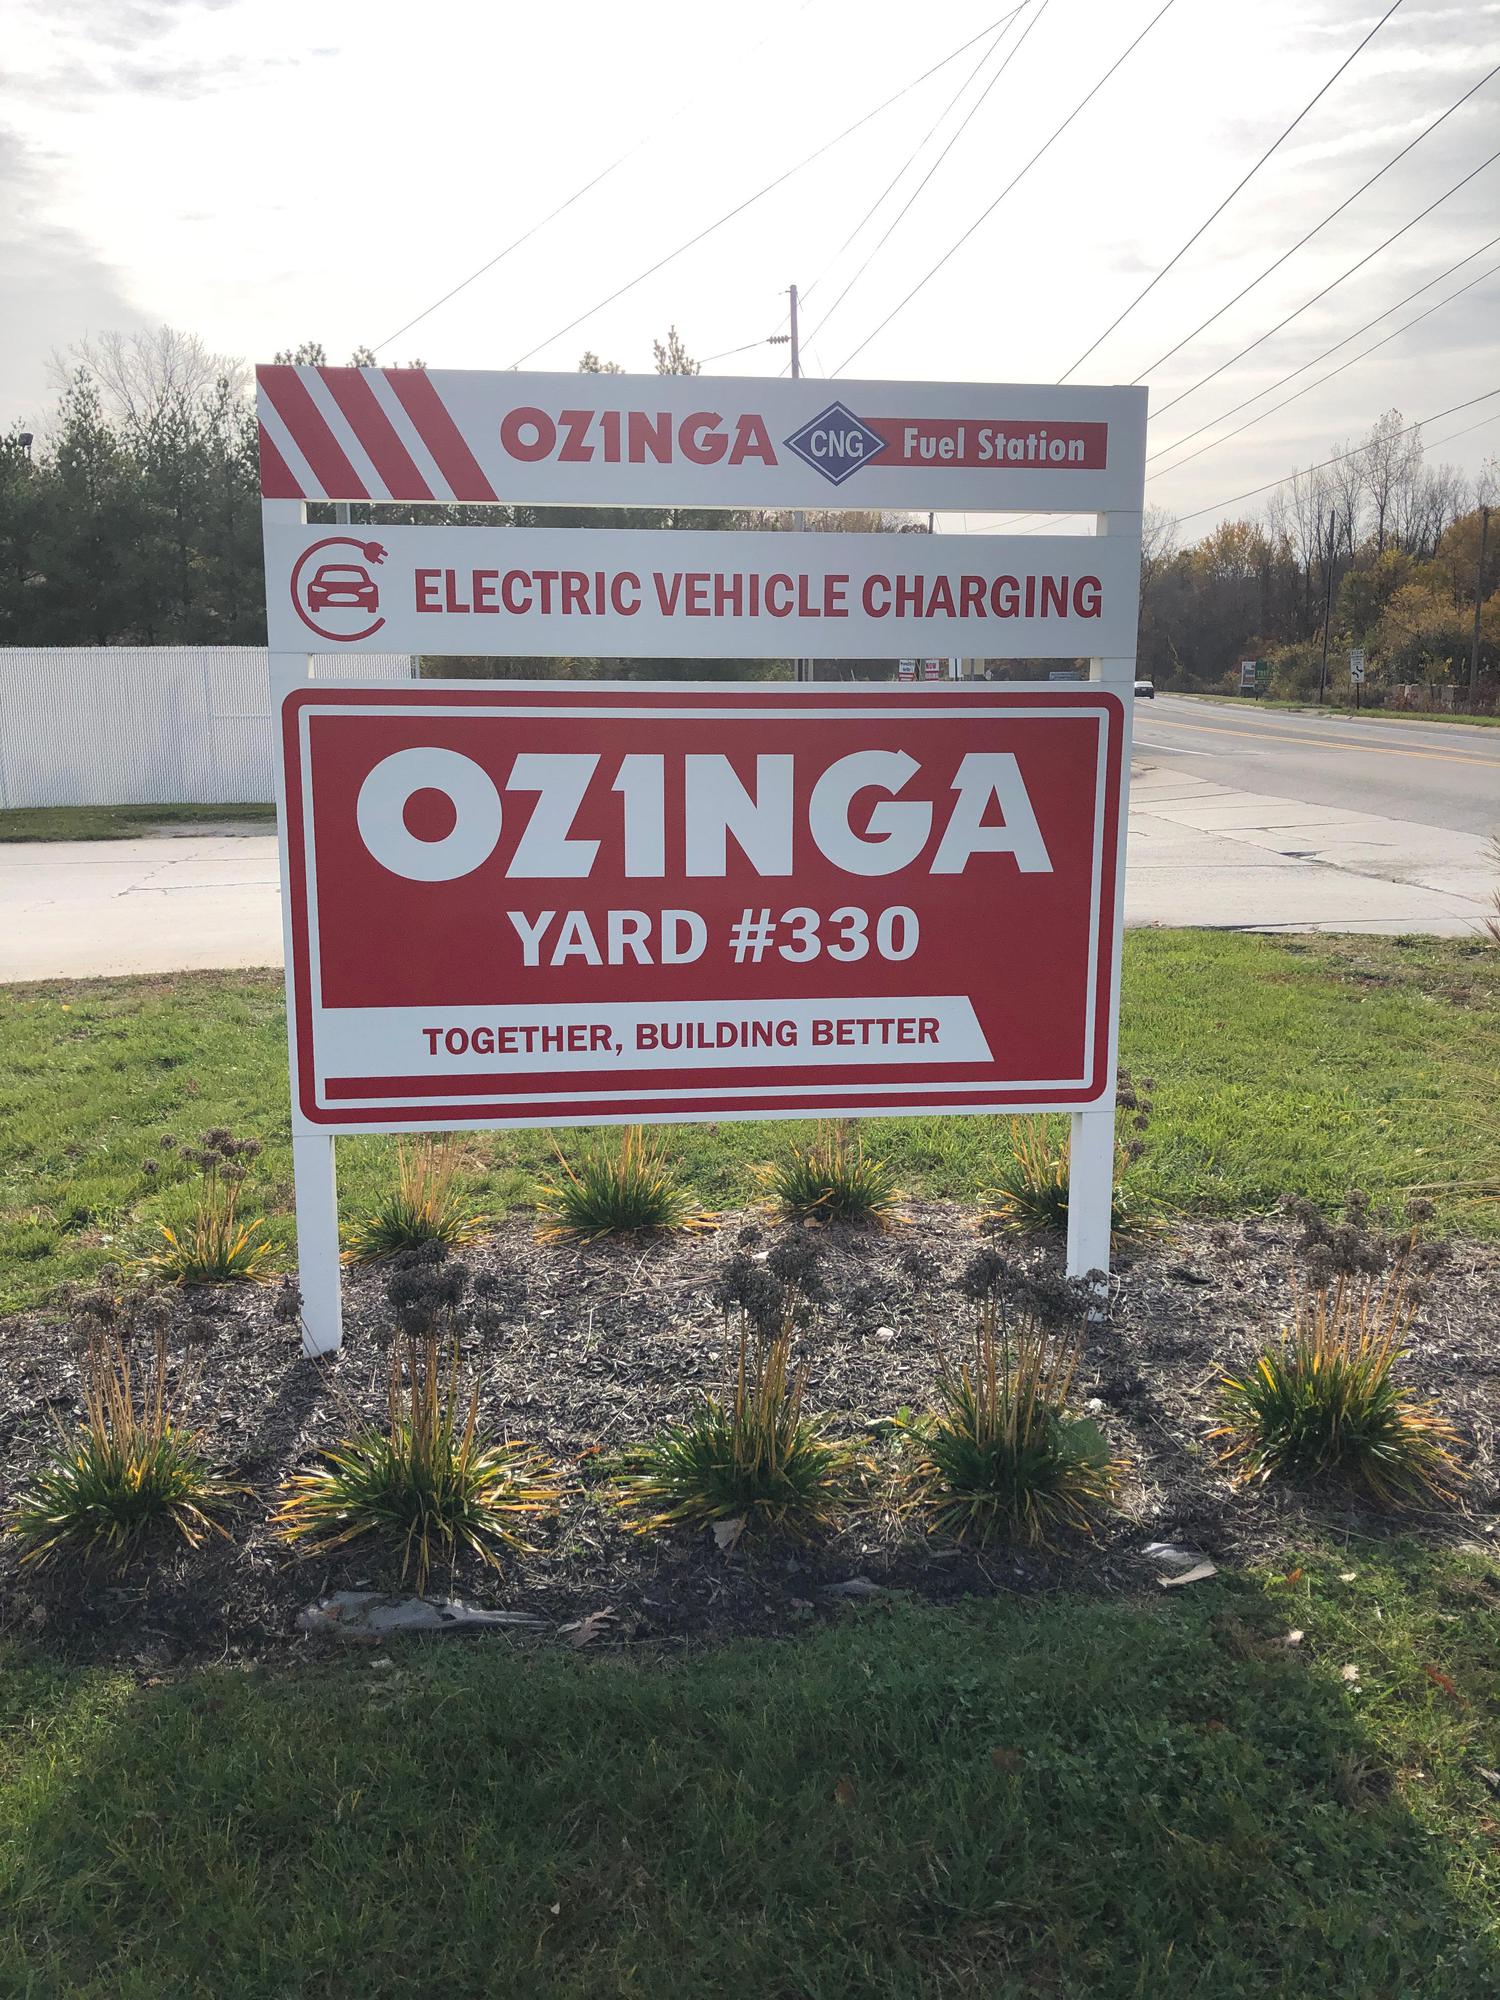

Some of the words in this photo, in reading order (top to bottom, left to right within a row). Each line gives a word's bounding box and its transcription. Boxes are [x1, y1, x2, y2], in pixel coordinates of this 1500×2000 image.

[810, 430, 864, 457] CNG
[903, 417, 965, 459] Fuel
[977, 421, 1085, 461] Station
[414, 569, 641, 616] ELECTRIC
[652, 572, 849, 619] VEHICLE
[862, 574, 1102, 619] CHARGING
[506, 907, 708, 968] YARD
[728, 904, 921, 965] #330
[422, 1024, 623, 1056] TOGETHER,
[635, 1020, 799, 1050] BUILDING
[811, 1017, 941, 1046] BETTER
